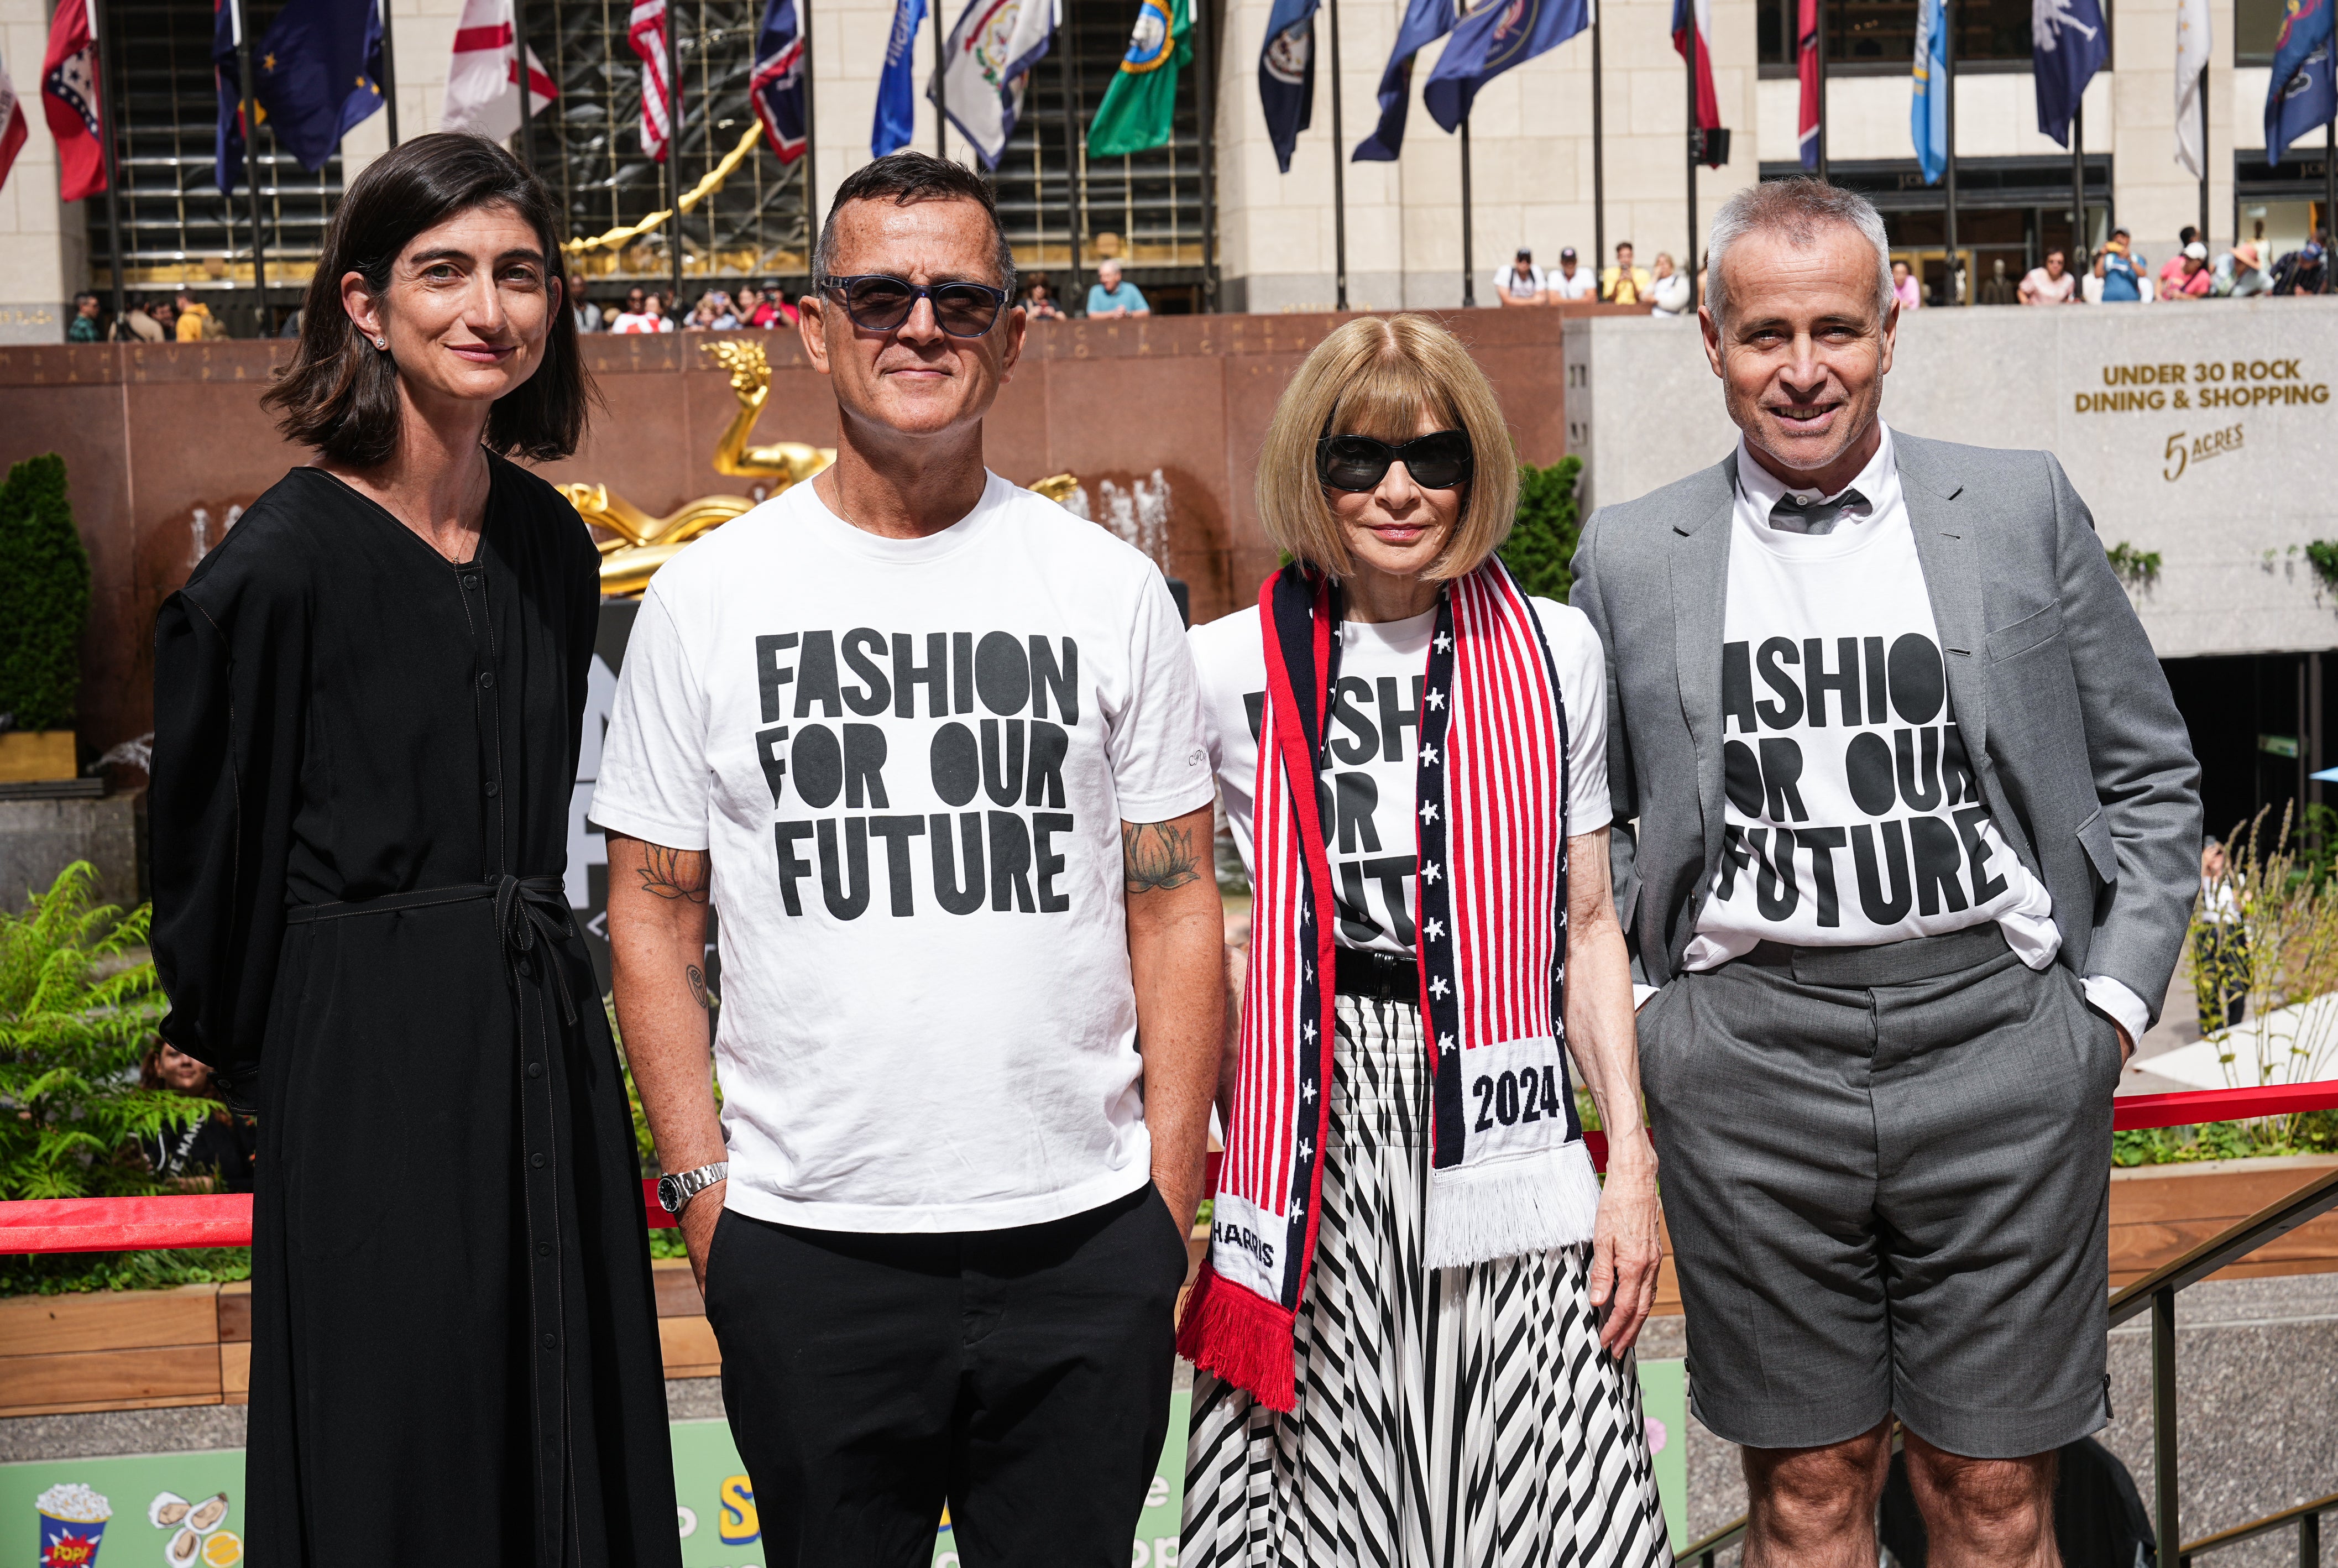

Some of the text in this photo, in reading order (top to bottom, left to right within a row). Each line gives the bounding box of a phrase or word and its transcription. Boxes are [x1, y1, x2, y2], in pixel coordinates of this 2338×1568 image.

[2075, 384, 2330, 413] DINING & SHOPPING
[2102, 359, 2301, 386] UNDER 30 ROCK
[2163, 423, 2243, 482] 5 ACRES
[756, 628, 1079, 725] FASHION
[1723, 633, 1956, 734] ASHIO
[756, 719, 1069, 809] FOR OUR
[1846, 725, 1979, 816] OUR
[775, 811, 1074, 921] FUTURE
[1716, 804, 2009, 927] FUTURE
[1473, 1065, 1560, 1133] 2024
[1213, 1220, 1274, 1268] HARRIS
[53, 1545, 89, 1562] POP!
